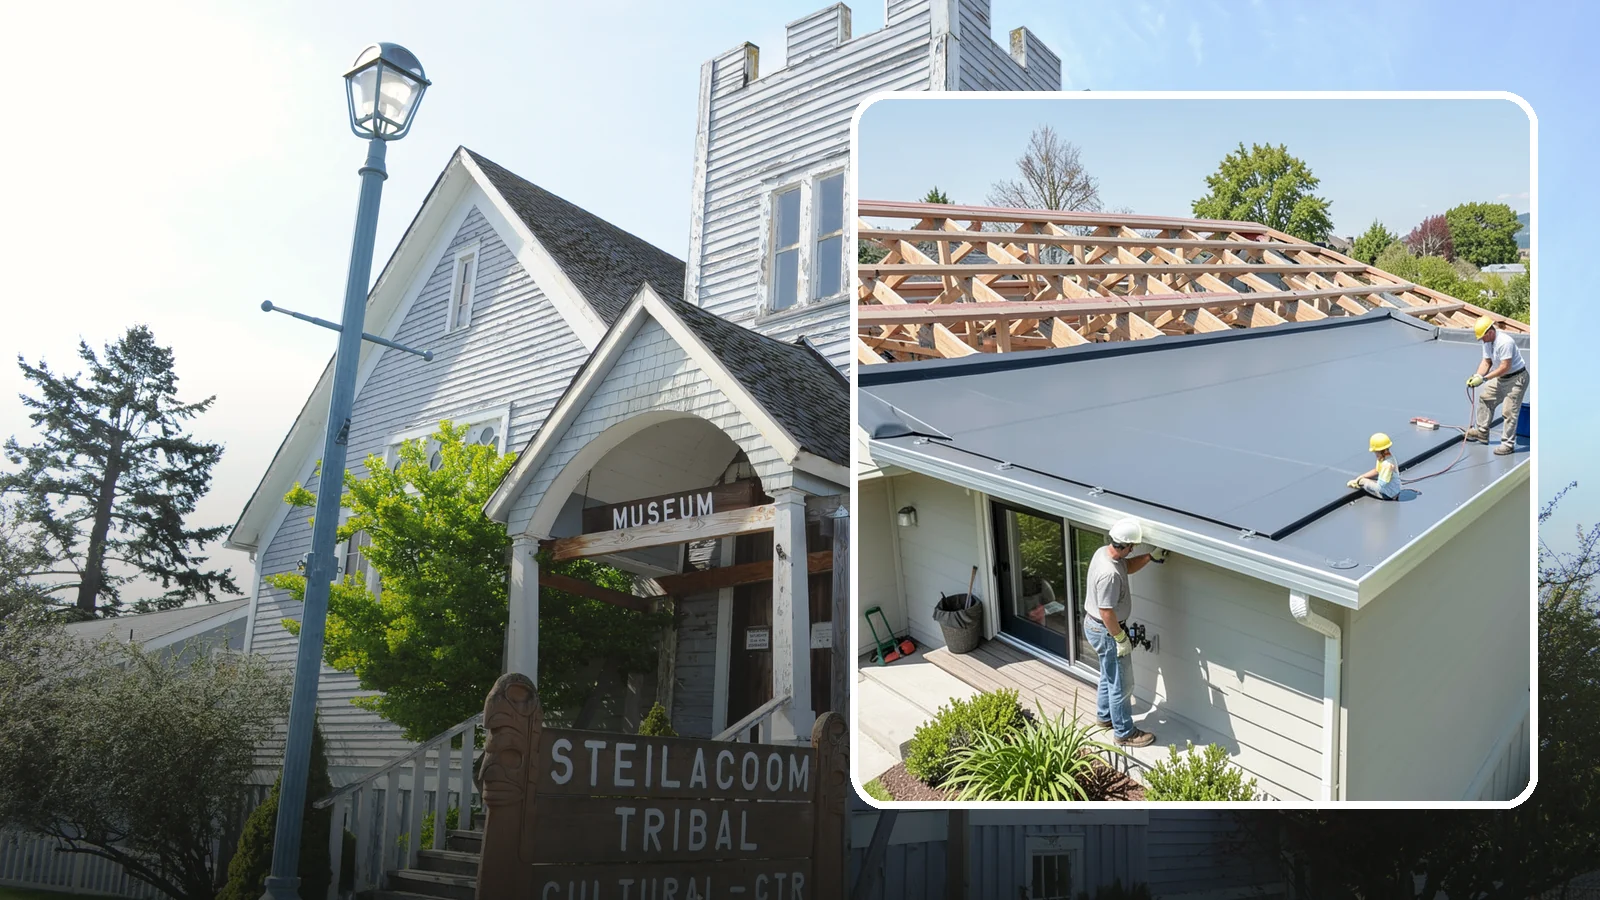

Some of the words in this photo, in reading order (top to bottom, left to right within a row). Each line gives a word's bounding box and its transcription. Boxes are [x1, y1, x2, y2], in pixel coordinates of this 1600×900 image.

[612, 491, 714, 531] MUSEUM
[550, 738, 810, 792] STEILACOOM
[614, 807, 758, 852] TRIBAL
